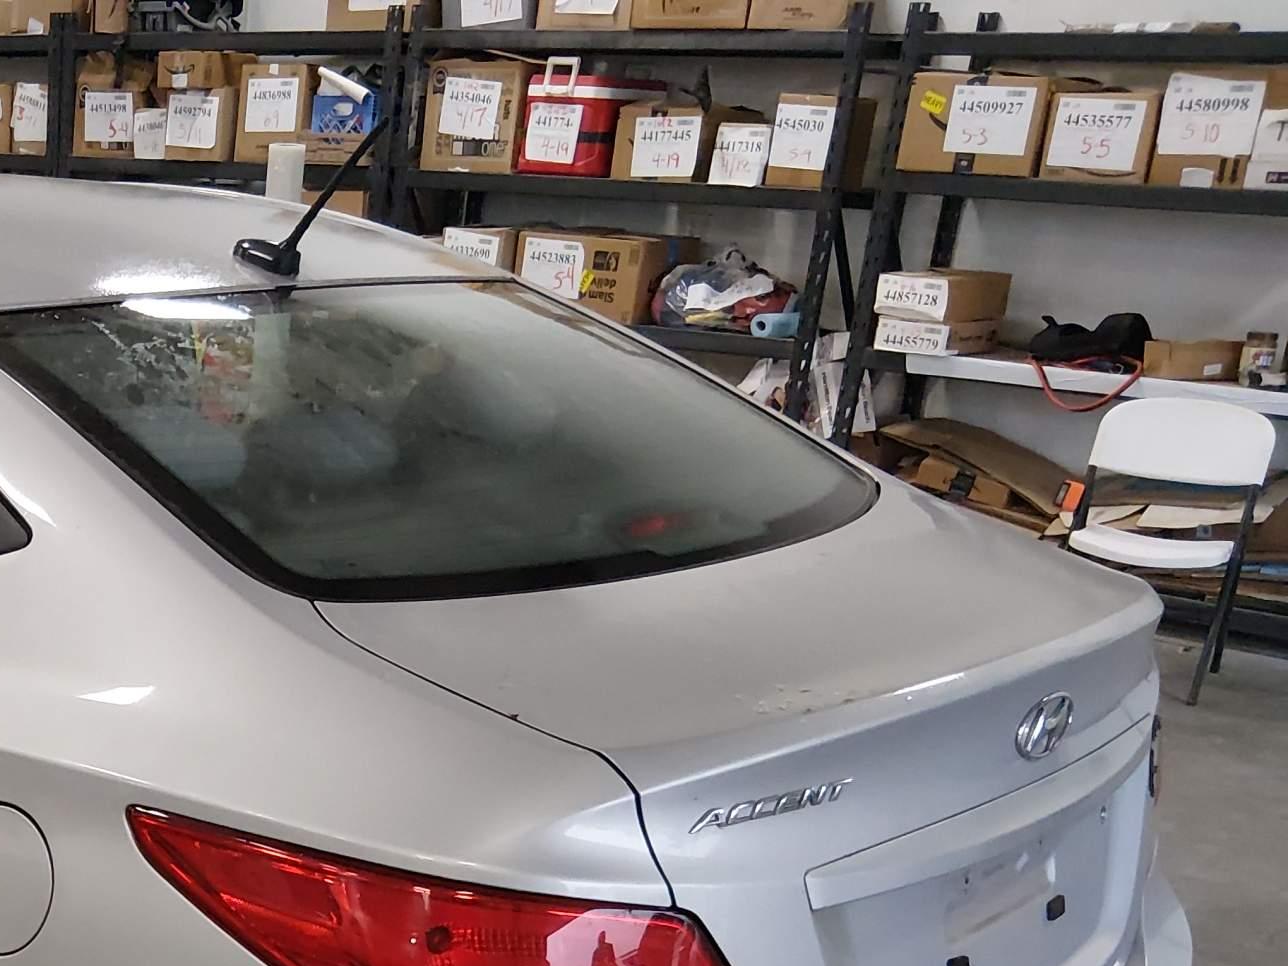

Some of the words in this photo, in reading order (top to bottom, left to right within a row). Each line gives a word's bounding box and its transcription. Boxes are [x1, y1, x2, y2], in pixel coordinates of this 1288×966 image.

[449, 90, 492, 105] 44354046
[1175, 97, 1250, 112] 44580998
[90, 103, 127, 113] 44513498
[173, 103, 211, 117] 44592794
[960, 100, 1023, 116] 44509927
[535, 116, 573, 128] 441774
[1064, 113, 1132, 129] 44535577
[641, 129, 691, 142] 44177445
[651, 152, 680, 169] 4-19
[529, 251, 576, 264] 44523883
[883, 289, 939, 306] 44857128
[883, 333, 939, 351] 44455779
[688, 776, 856, 834] ACCENT
